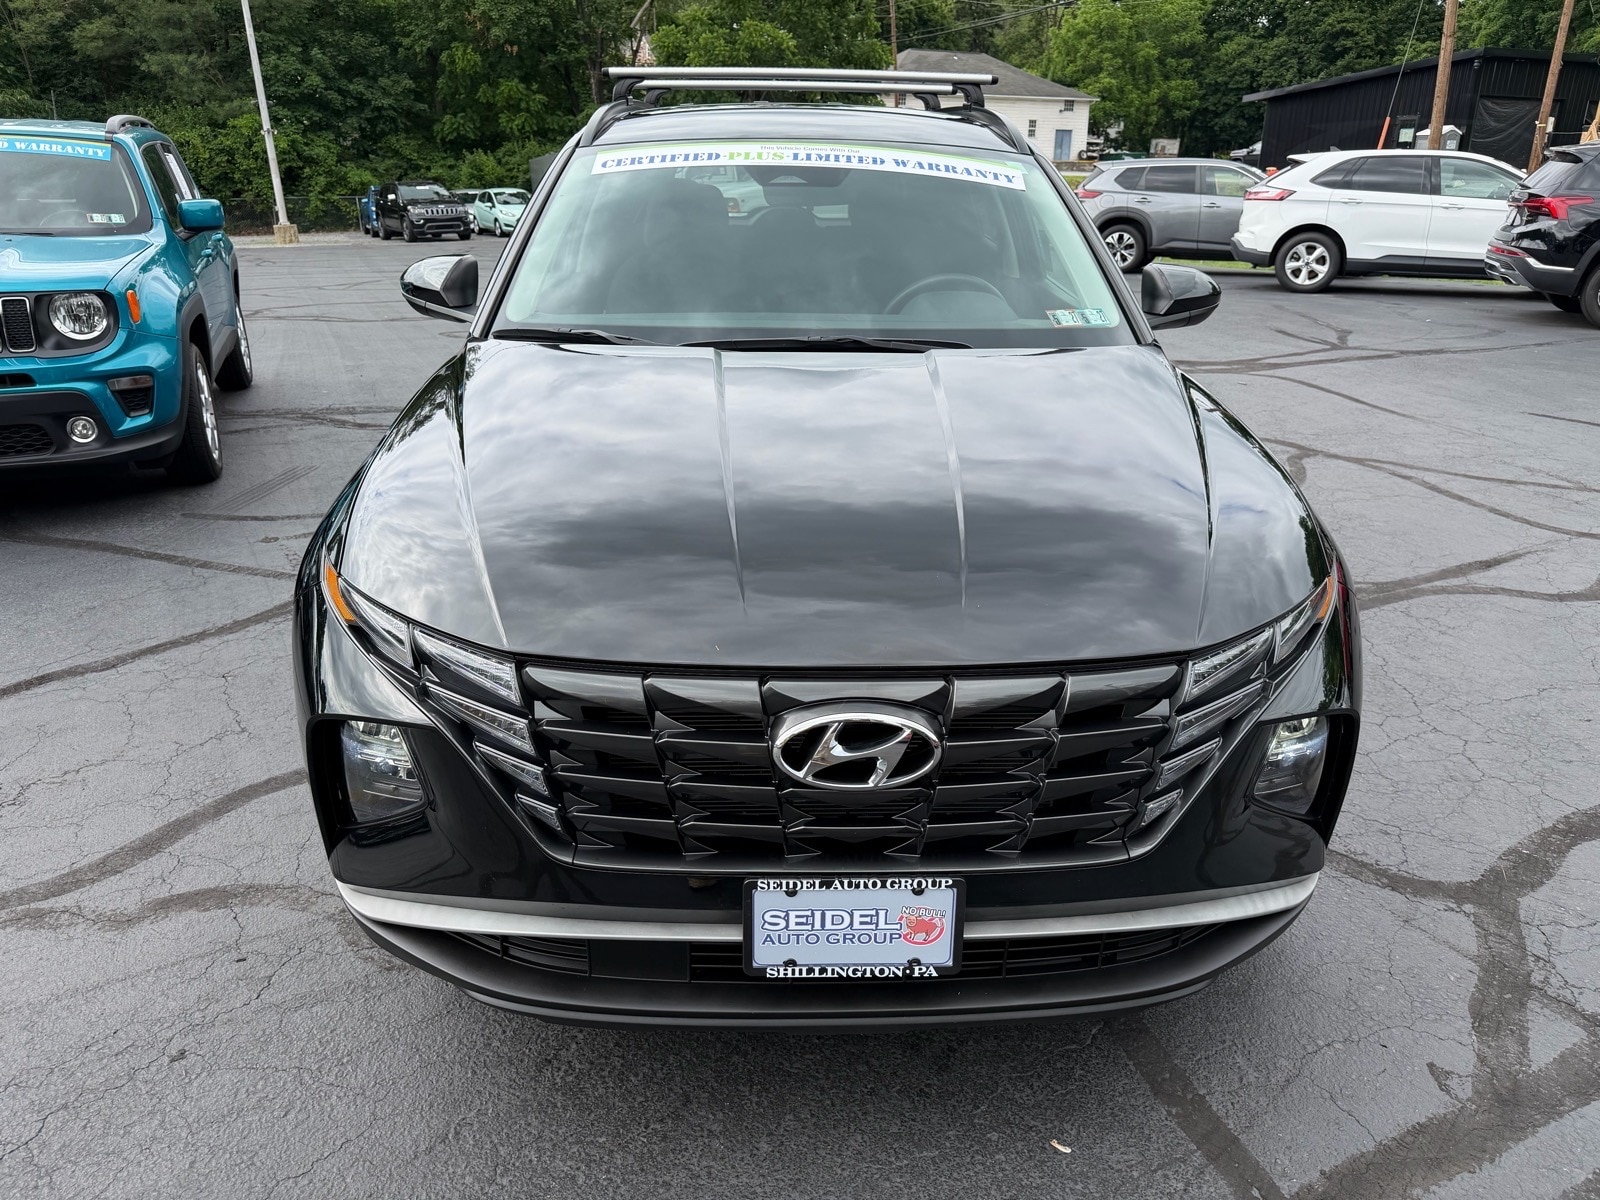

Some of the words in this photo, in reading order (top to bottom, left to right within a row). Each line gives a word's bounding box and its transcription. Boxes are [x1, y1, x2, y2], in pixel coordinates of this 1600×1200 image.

[14, 141, 106, 157] WARRANTY
[892, 158, 1017, 184] WARRANTY
[757, 879, 826, 891] SEIDEL
[830, 879, 882, 891] AUTO
[886, 878, 953, 890] GROUP
[901, 906, 917, 916] NO
[761, 908, 903, 932] SEIDEL
[761, 933, 820, 946] AUTO
[825, 932, 902, 945] GROUP
[766, 965, 904, 978] SHILLINGTON
[912, 966, 938, 977] PA
